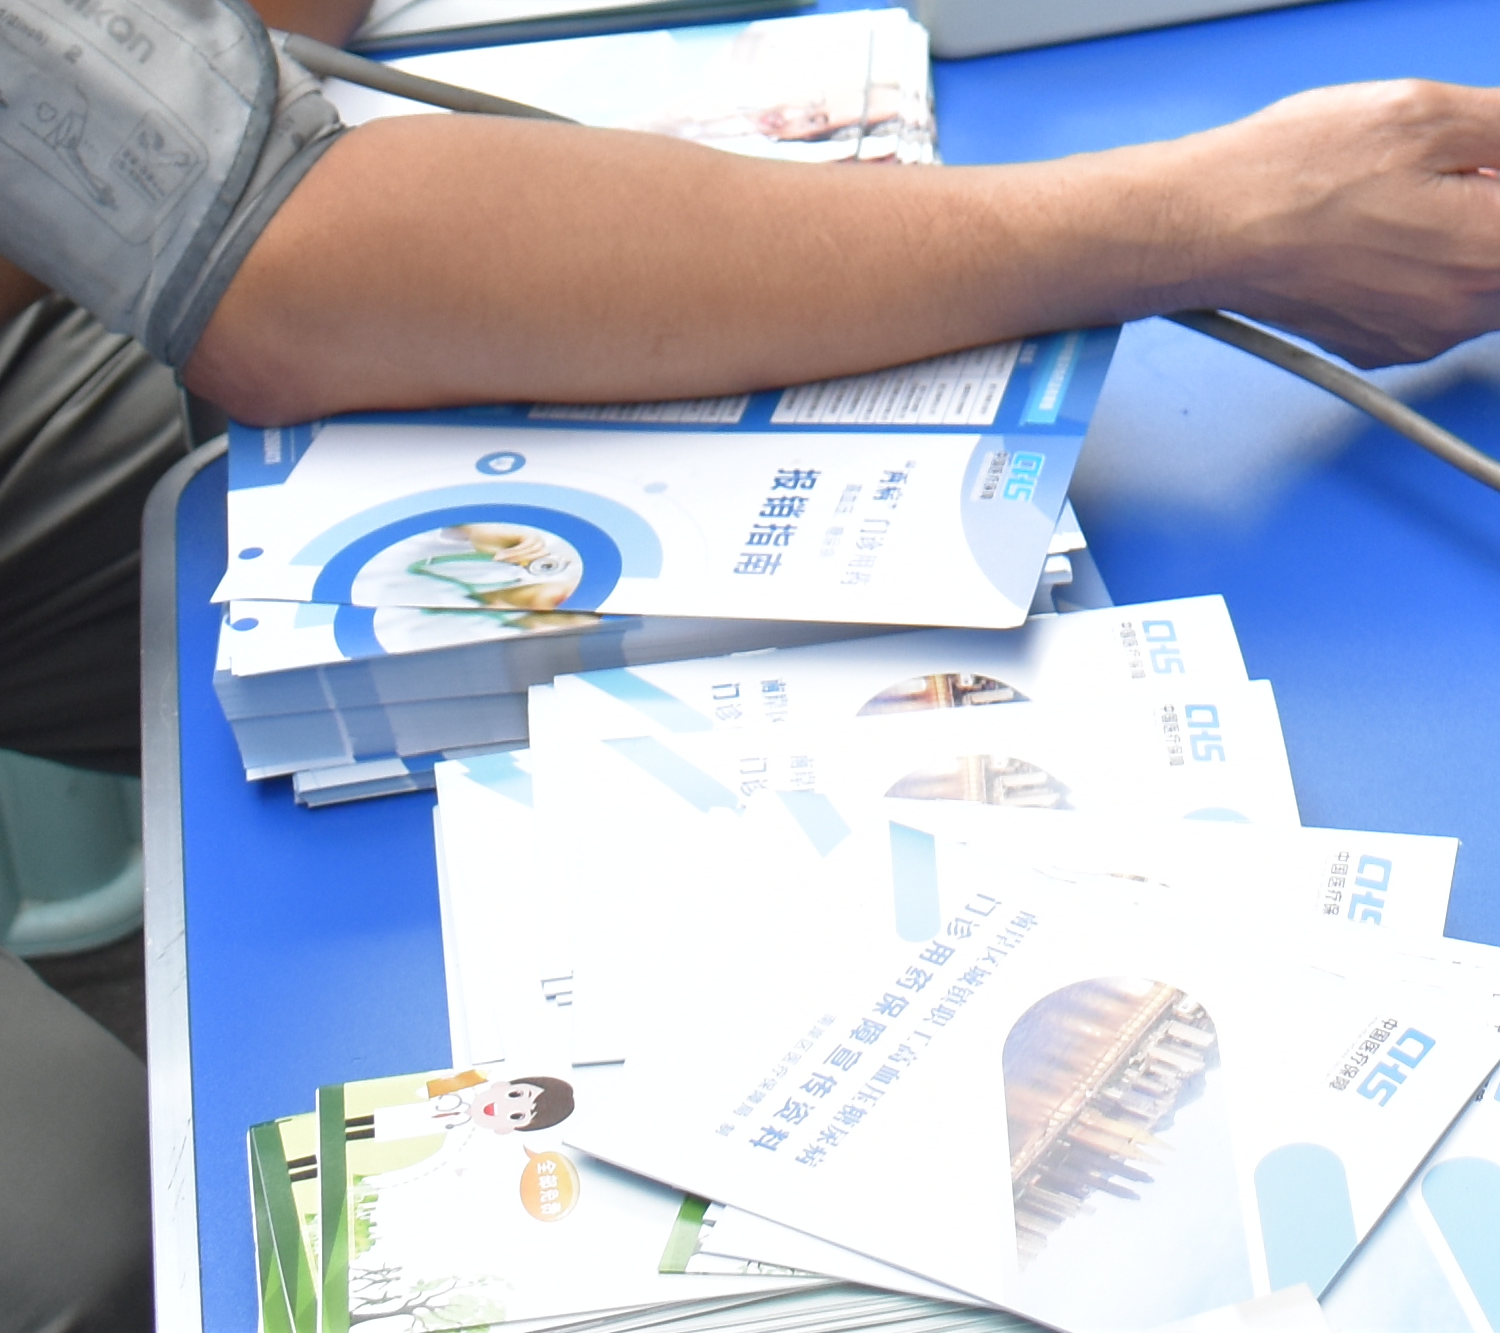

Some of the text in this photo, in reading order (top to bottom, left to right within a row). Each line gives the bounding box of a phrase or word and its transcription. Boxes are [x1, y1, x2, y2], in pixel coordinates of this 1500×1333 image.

[733, 467, 822, 576] 报销指南
[749, 893, 1003, 1151] 门诊用药保障宣传资料
[1328, 1017, 1399, 1093] 中国医疗保障
